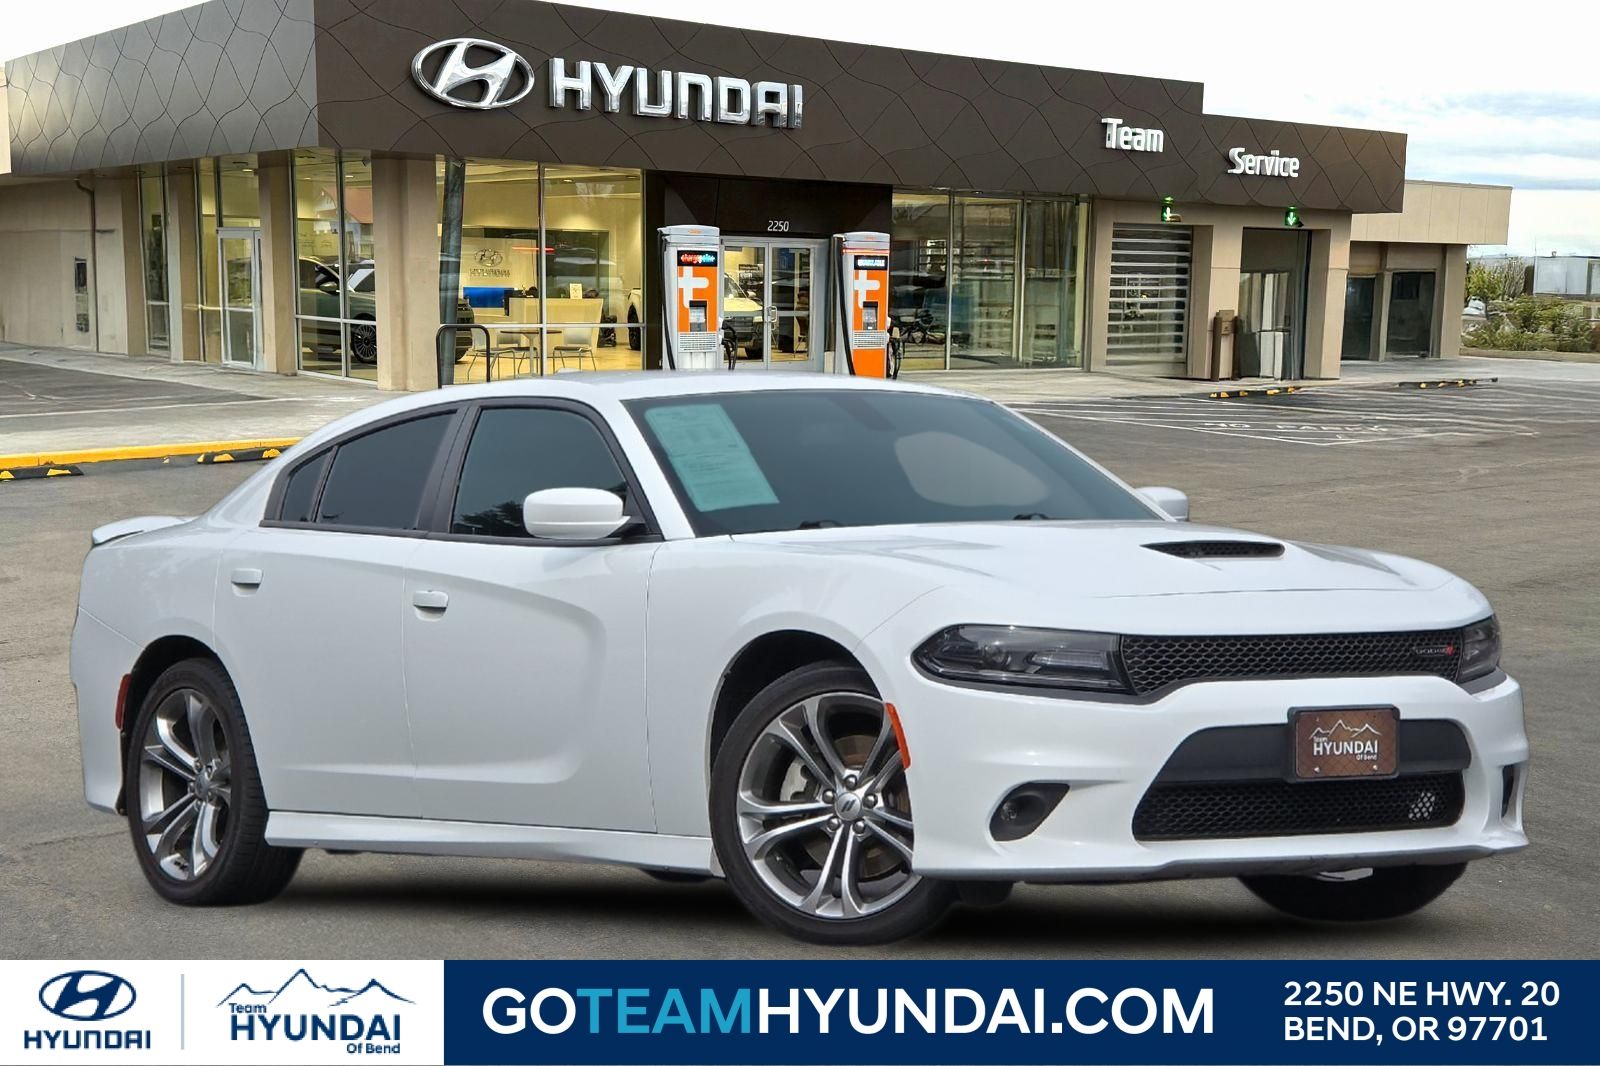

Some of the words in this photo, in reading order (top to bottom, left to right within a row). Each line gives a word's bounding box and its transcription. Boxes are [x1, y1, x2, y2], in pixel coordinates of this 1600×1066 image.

[549, 57, 803, 129] HYUNDAI
[1101, 117, 1164, 153] Team
[1227, 147, 1300, 178] Service
[767, 220, 790, 232] 2250
[1313, 740, 1379, 756] HYUNDAI
